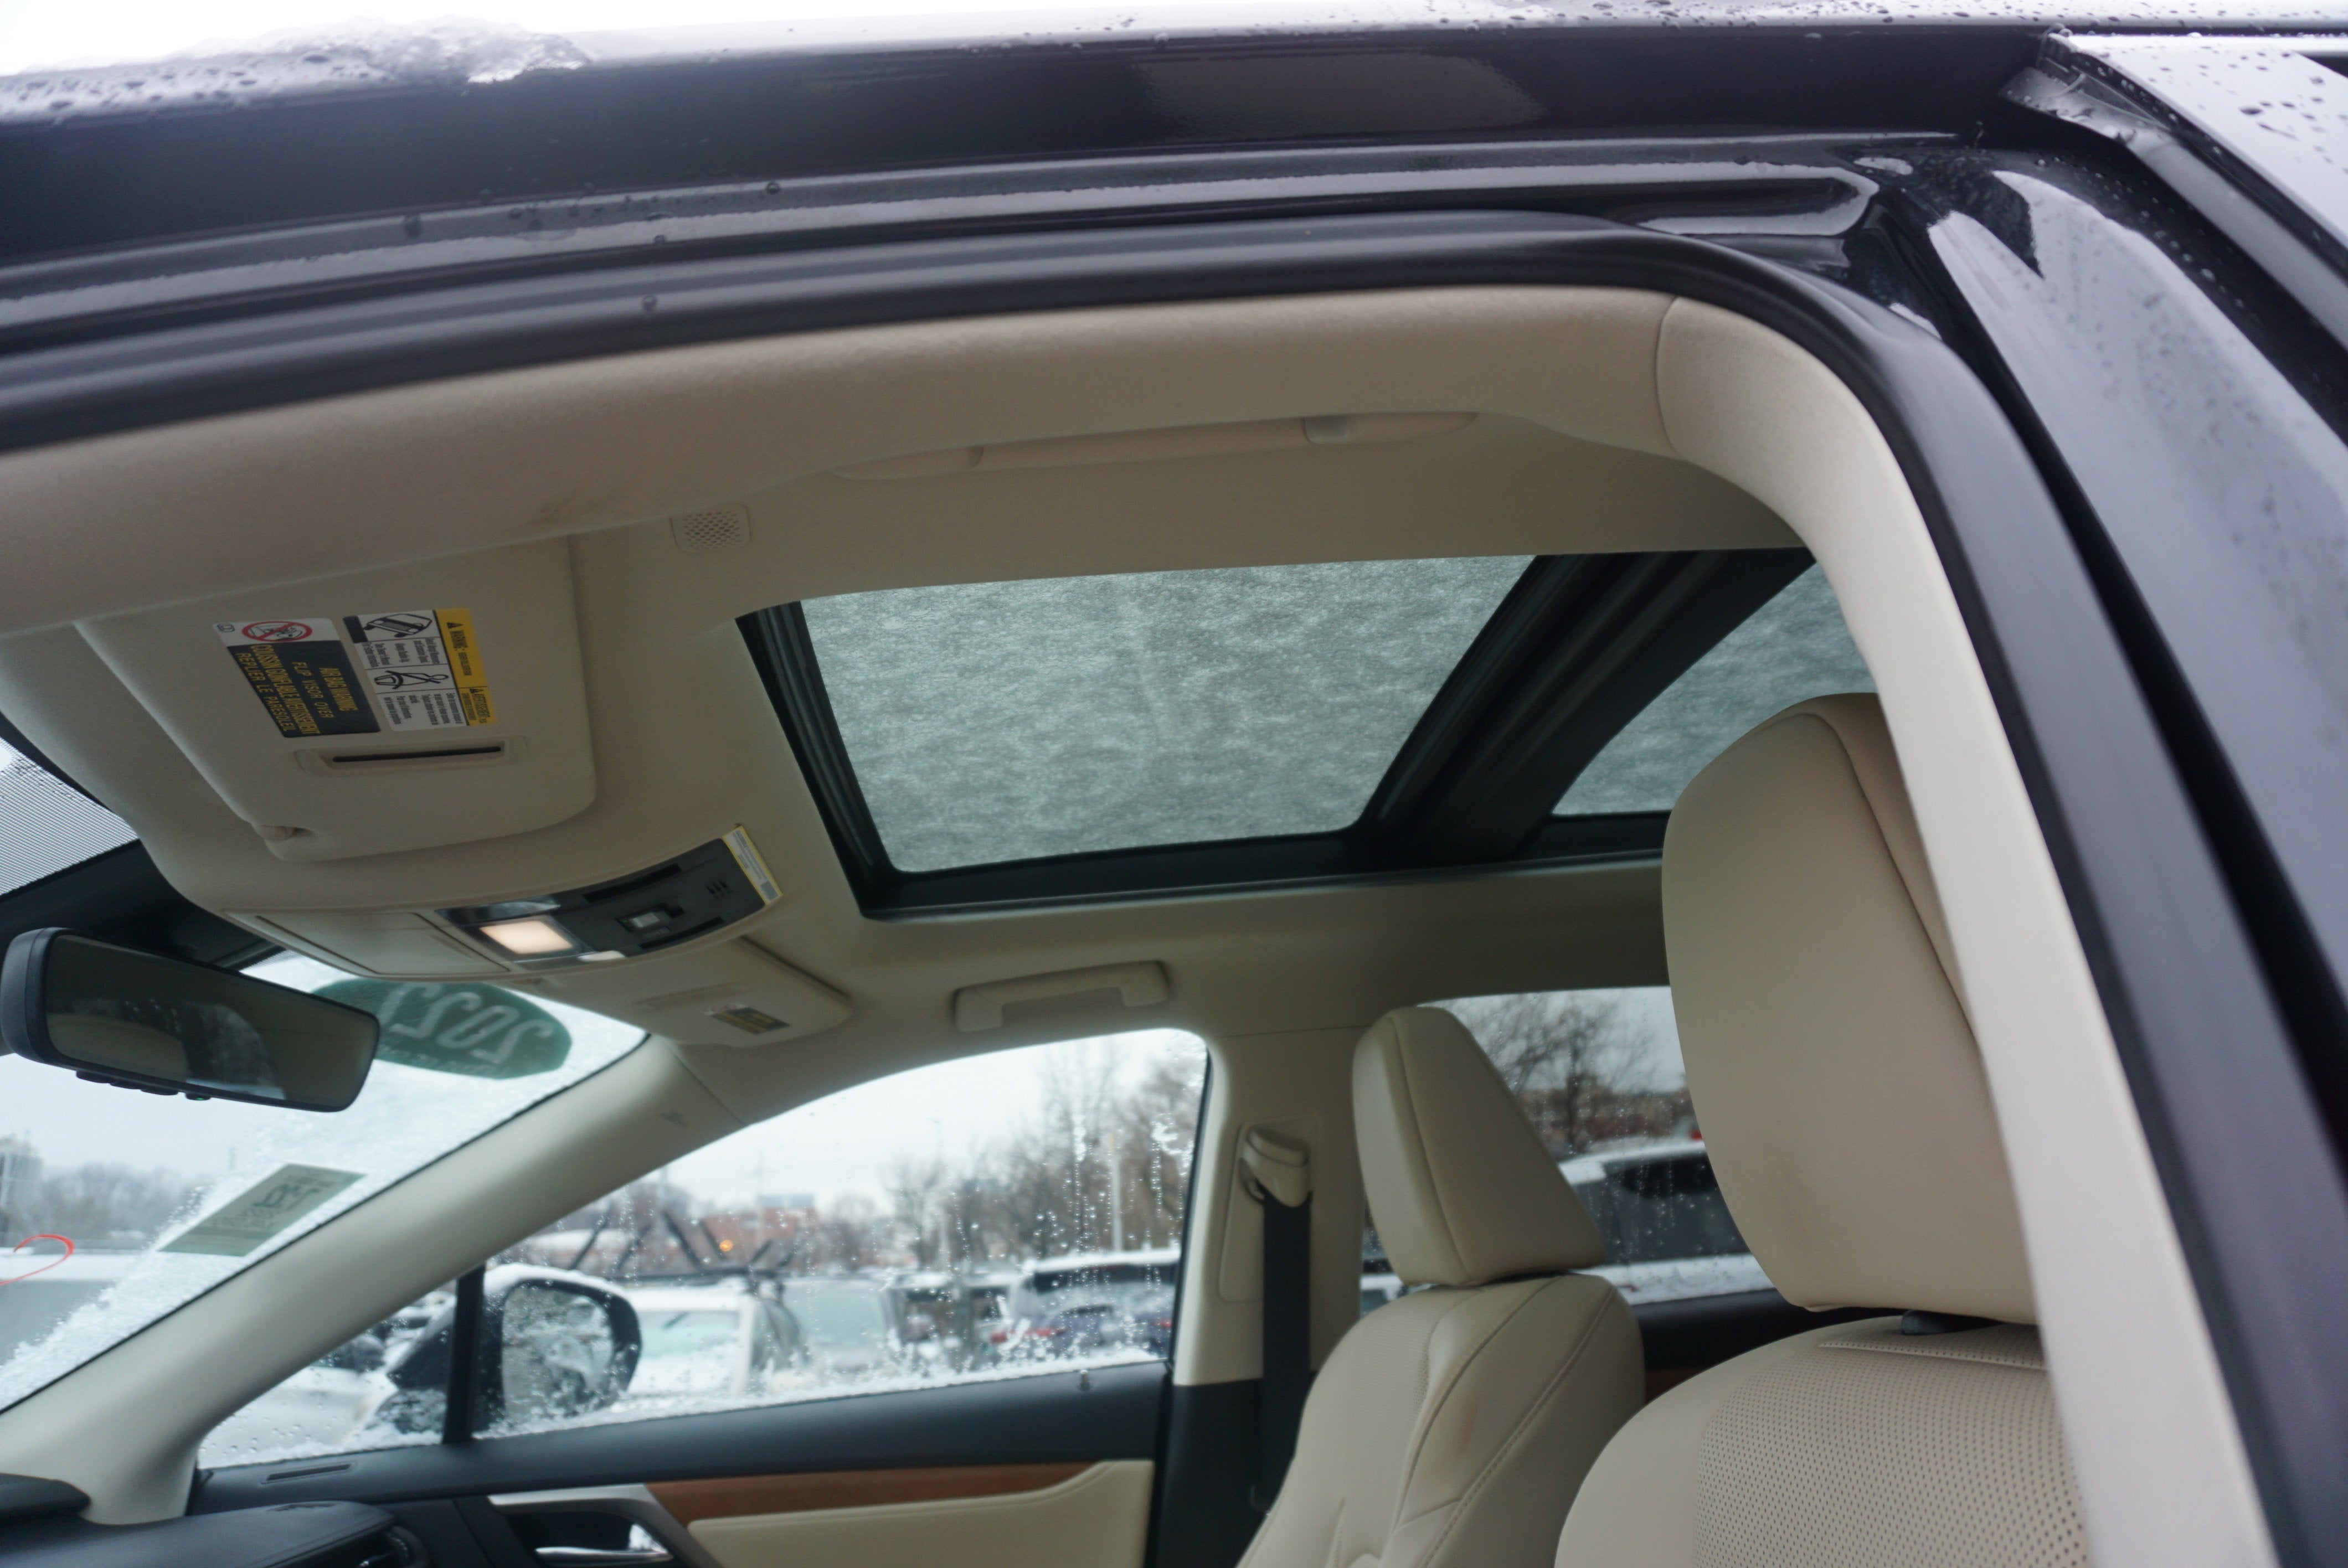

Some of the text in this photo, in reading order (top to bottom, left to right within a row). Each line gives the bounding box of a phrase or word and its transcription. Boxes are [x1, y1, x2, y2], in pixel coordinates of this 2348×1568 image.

[236, 653, 265, 680] REPLIER
[264, 697, 296, 731] PARESOLEIL
[250, 644, 319, 734] COUSSIN GONFLABLE AVERTISSEMENT
[292, 662, 333, 718] FLIP VISOR OVER
[330, 688, 357, 711] WARNING
